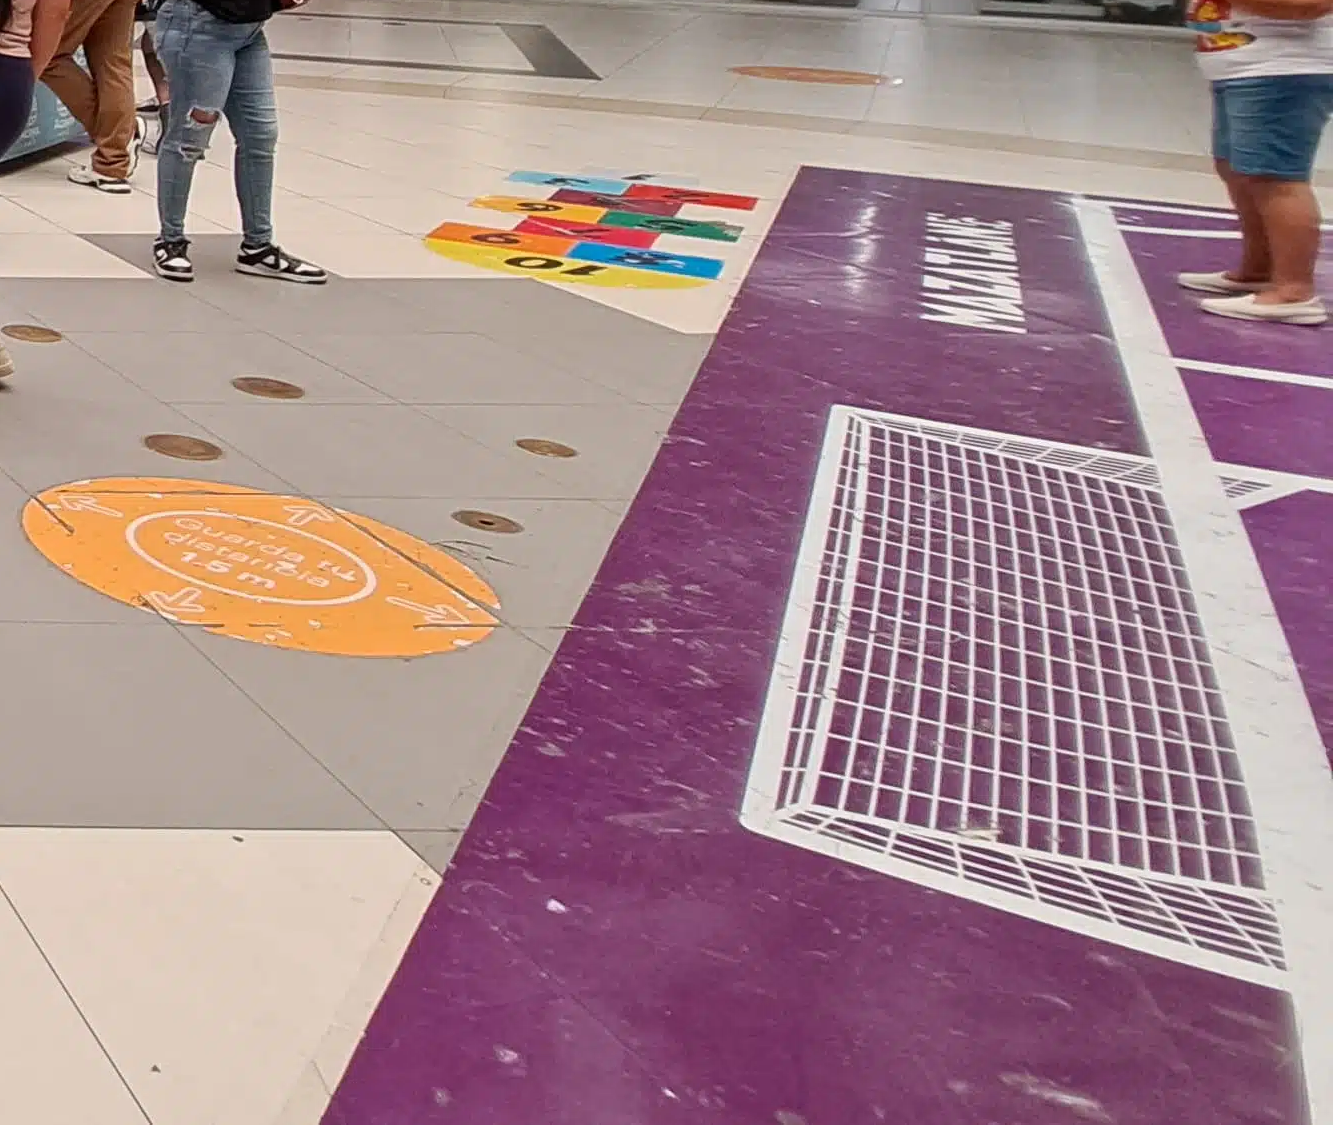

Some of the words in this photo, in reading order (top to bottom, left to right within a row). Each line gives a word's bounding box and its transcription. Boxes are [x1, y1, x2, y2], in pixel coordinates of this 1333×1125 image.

[503, 257, 608, 276] 10
[174, 517, 305, 563] Guarda
[236, 571, 277, 590] m
